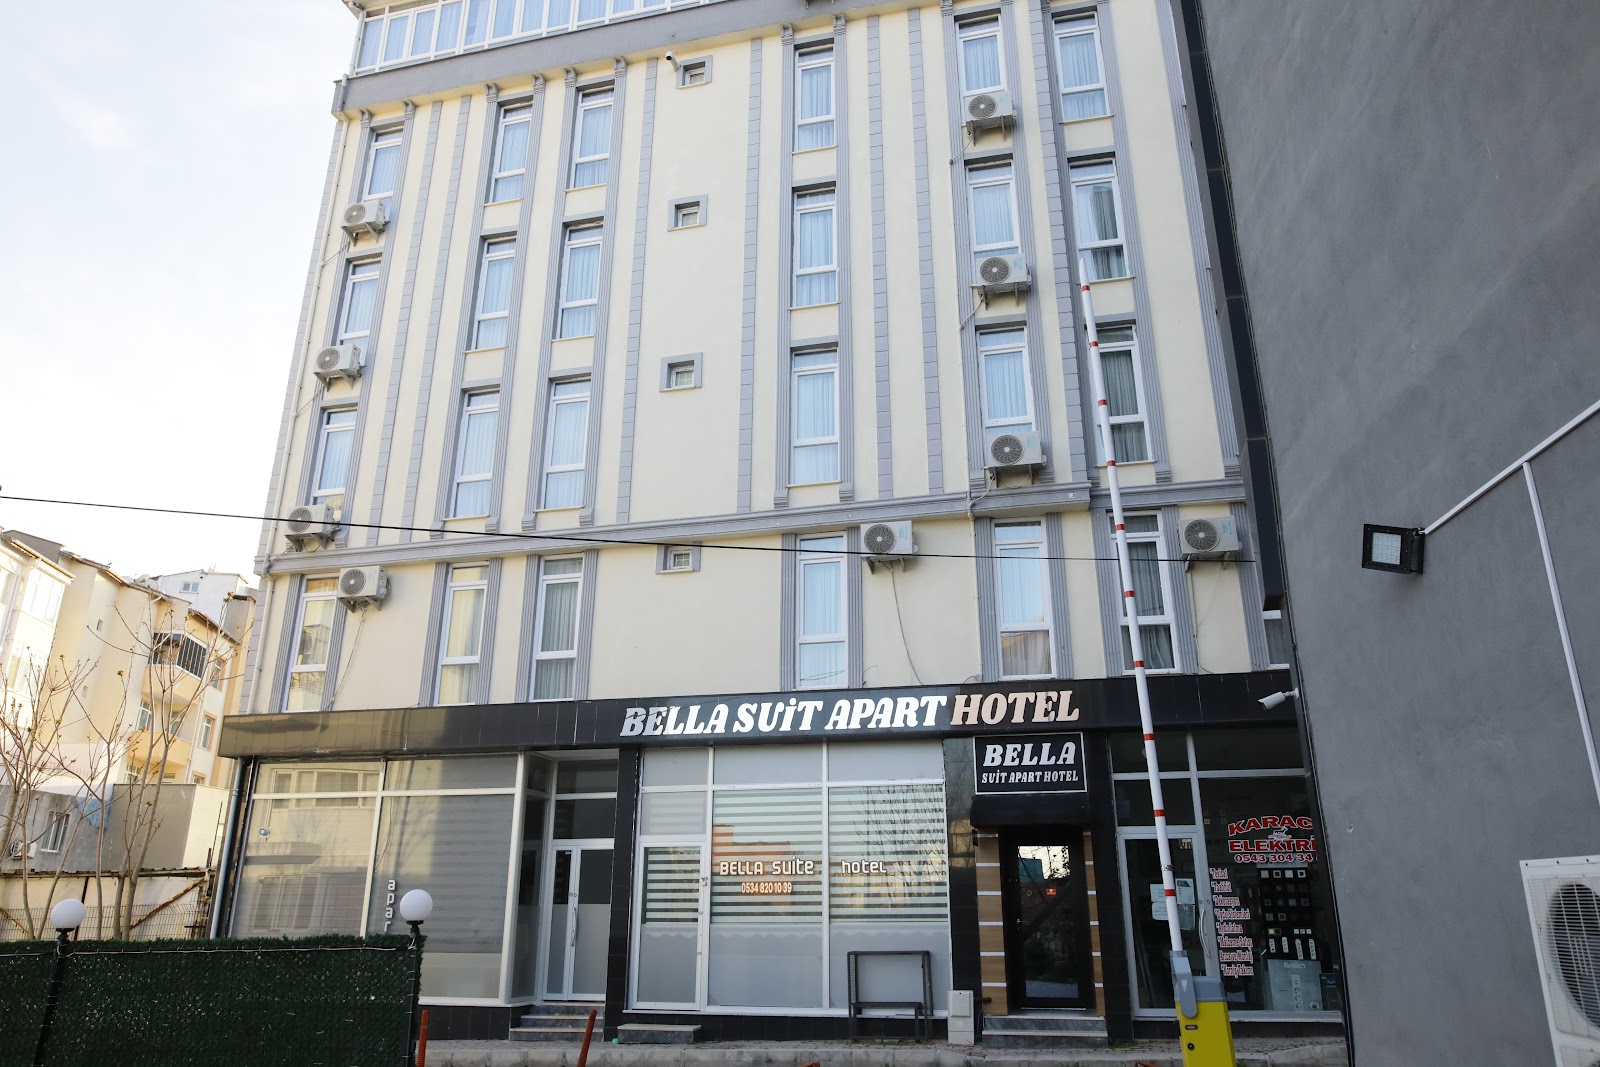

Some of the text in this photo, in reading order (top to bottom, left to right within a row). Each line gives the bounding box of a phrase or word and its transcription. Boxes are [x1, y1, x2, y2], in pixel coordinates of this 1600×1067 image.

[620, 704, 729, 736] BELLA
[824, 695, 947, 730] APART
[950, 690, 1080, 726] HOTEL
[983, 741, 1077, 767] BELLA
[1008, 771, 1042, 783] APART
[1043, 770, 1079, 782] HOTEL
[1234, 853, 1267, 863] 0543
[1269, 853, 1294, 863] 304
[720, 861, 764, 876] BELLA
[741, 881, 792, 893] 0534 820 10 39
